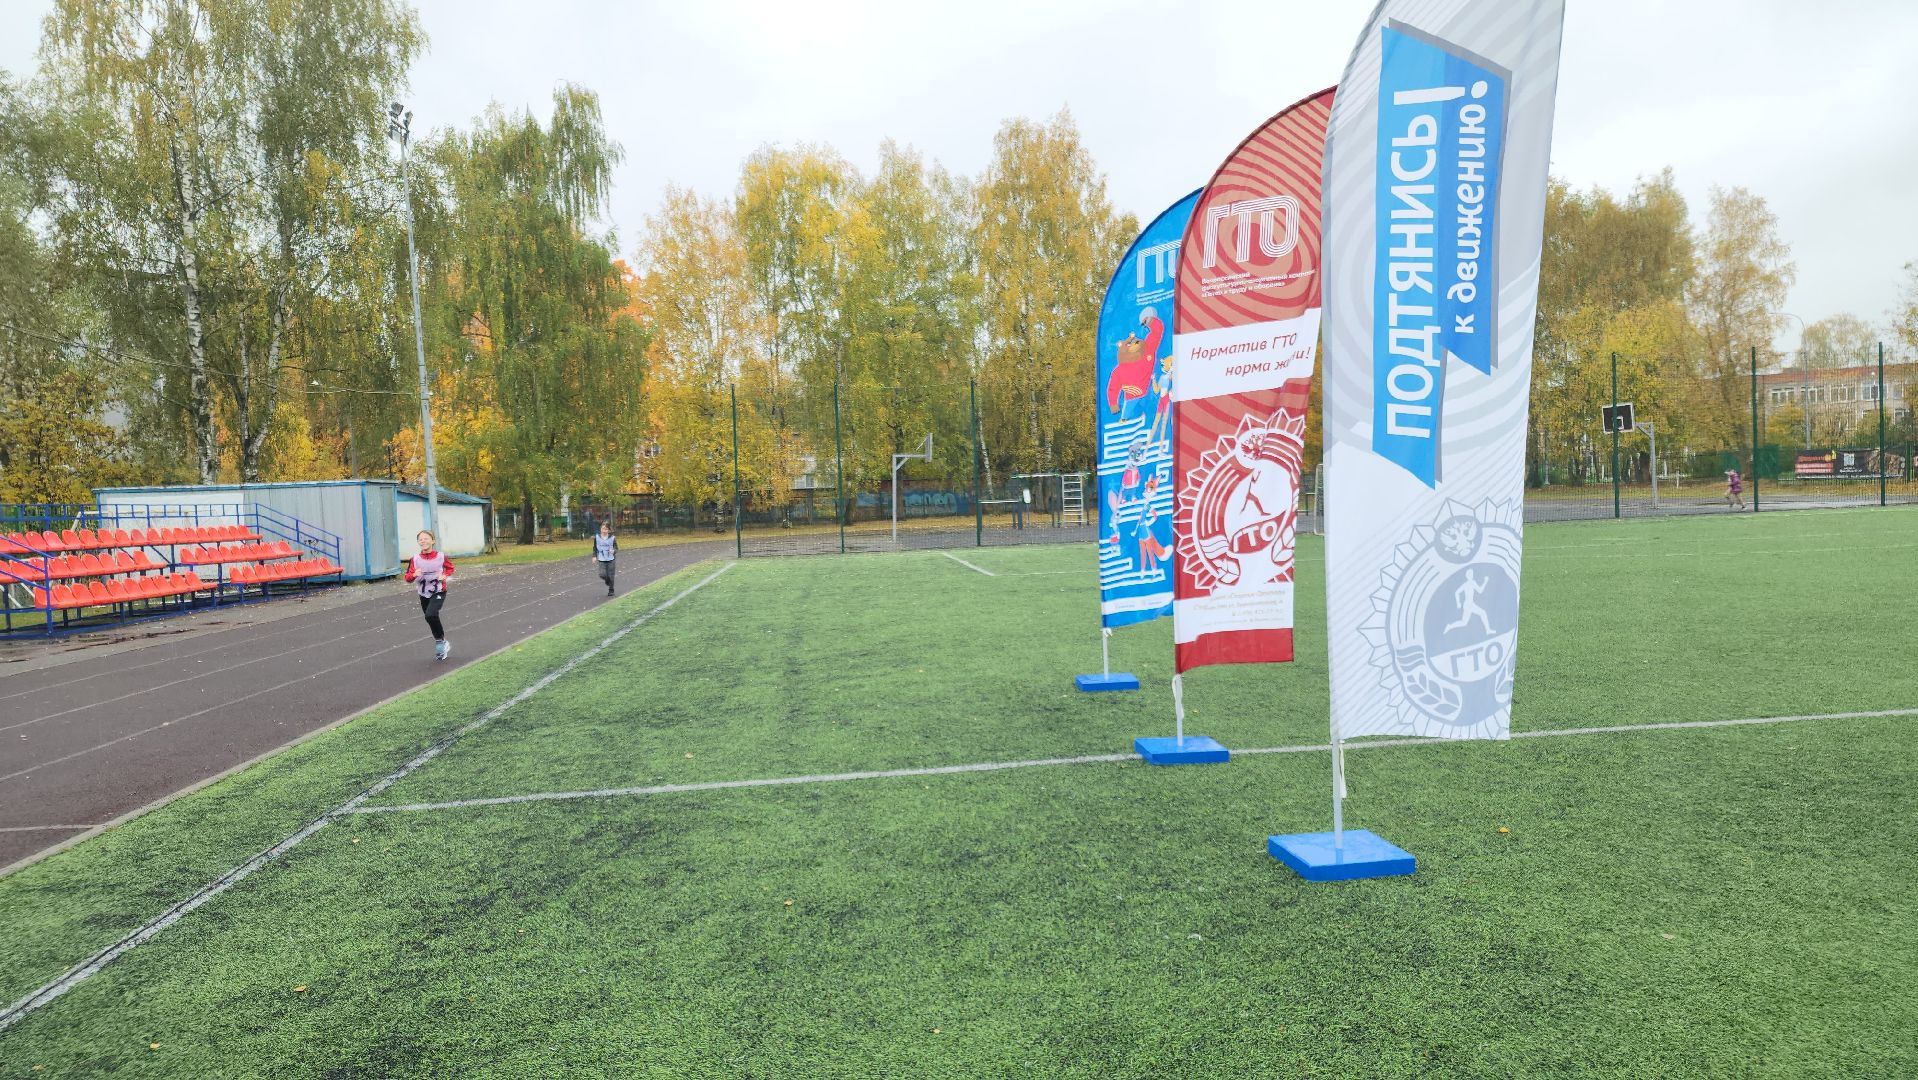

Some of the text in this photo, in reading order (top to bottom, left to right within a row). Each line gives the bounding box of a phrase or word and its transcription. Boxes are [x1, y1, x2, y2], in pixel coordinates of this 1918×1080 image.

[1203, 195, 1299, 269] ГТО
[1455, 313, 1474, 333] к
[1190, 332, 1297, 360] Норматив ГТО
[1225, 361, 1271, 377] норма
[1233, 521, 1278, 553] ГТО
[420, 578, 439, 594] 13
[1450, 641, 1503, 678] ГТО
